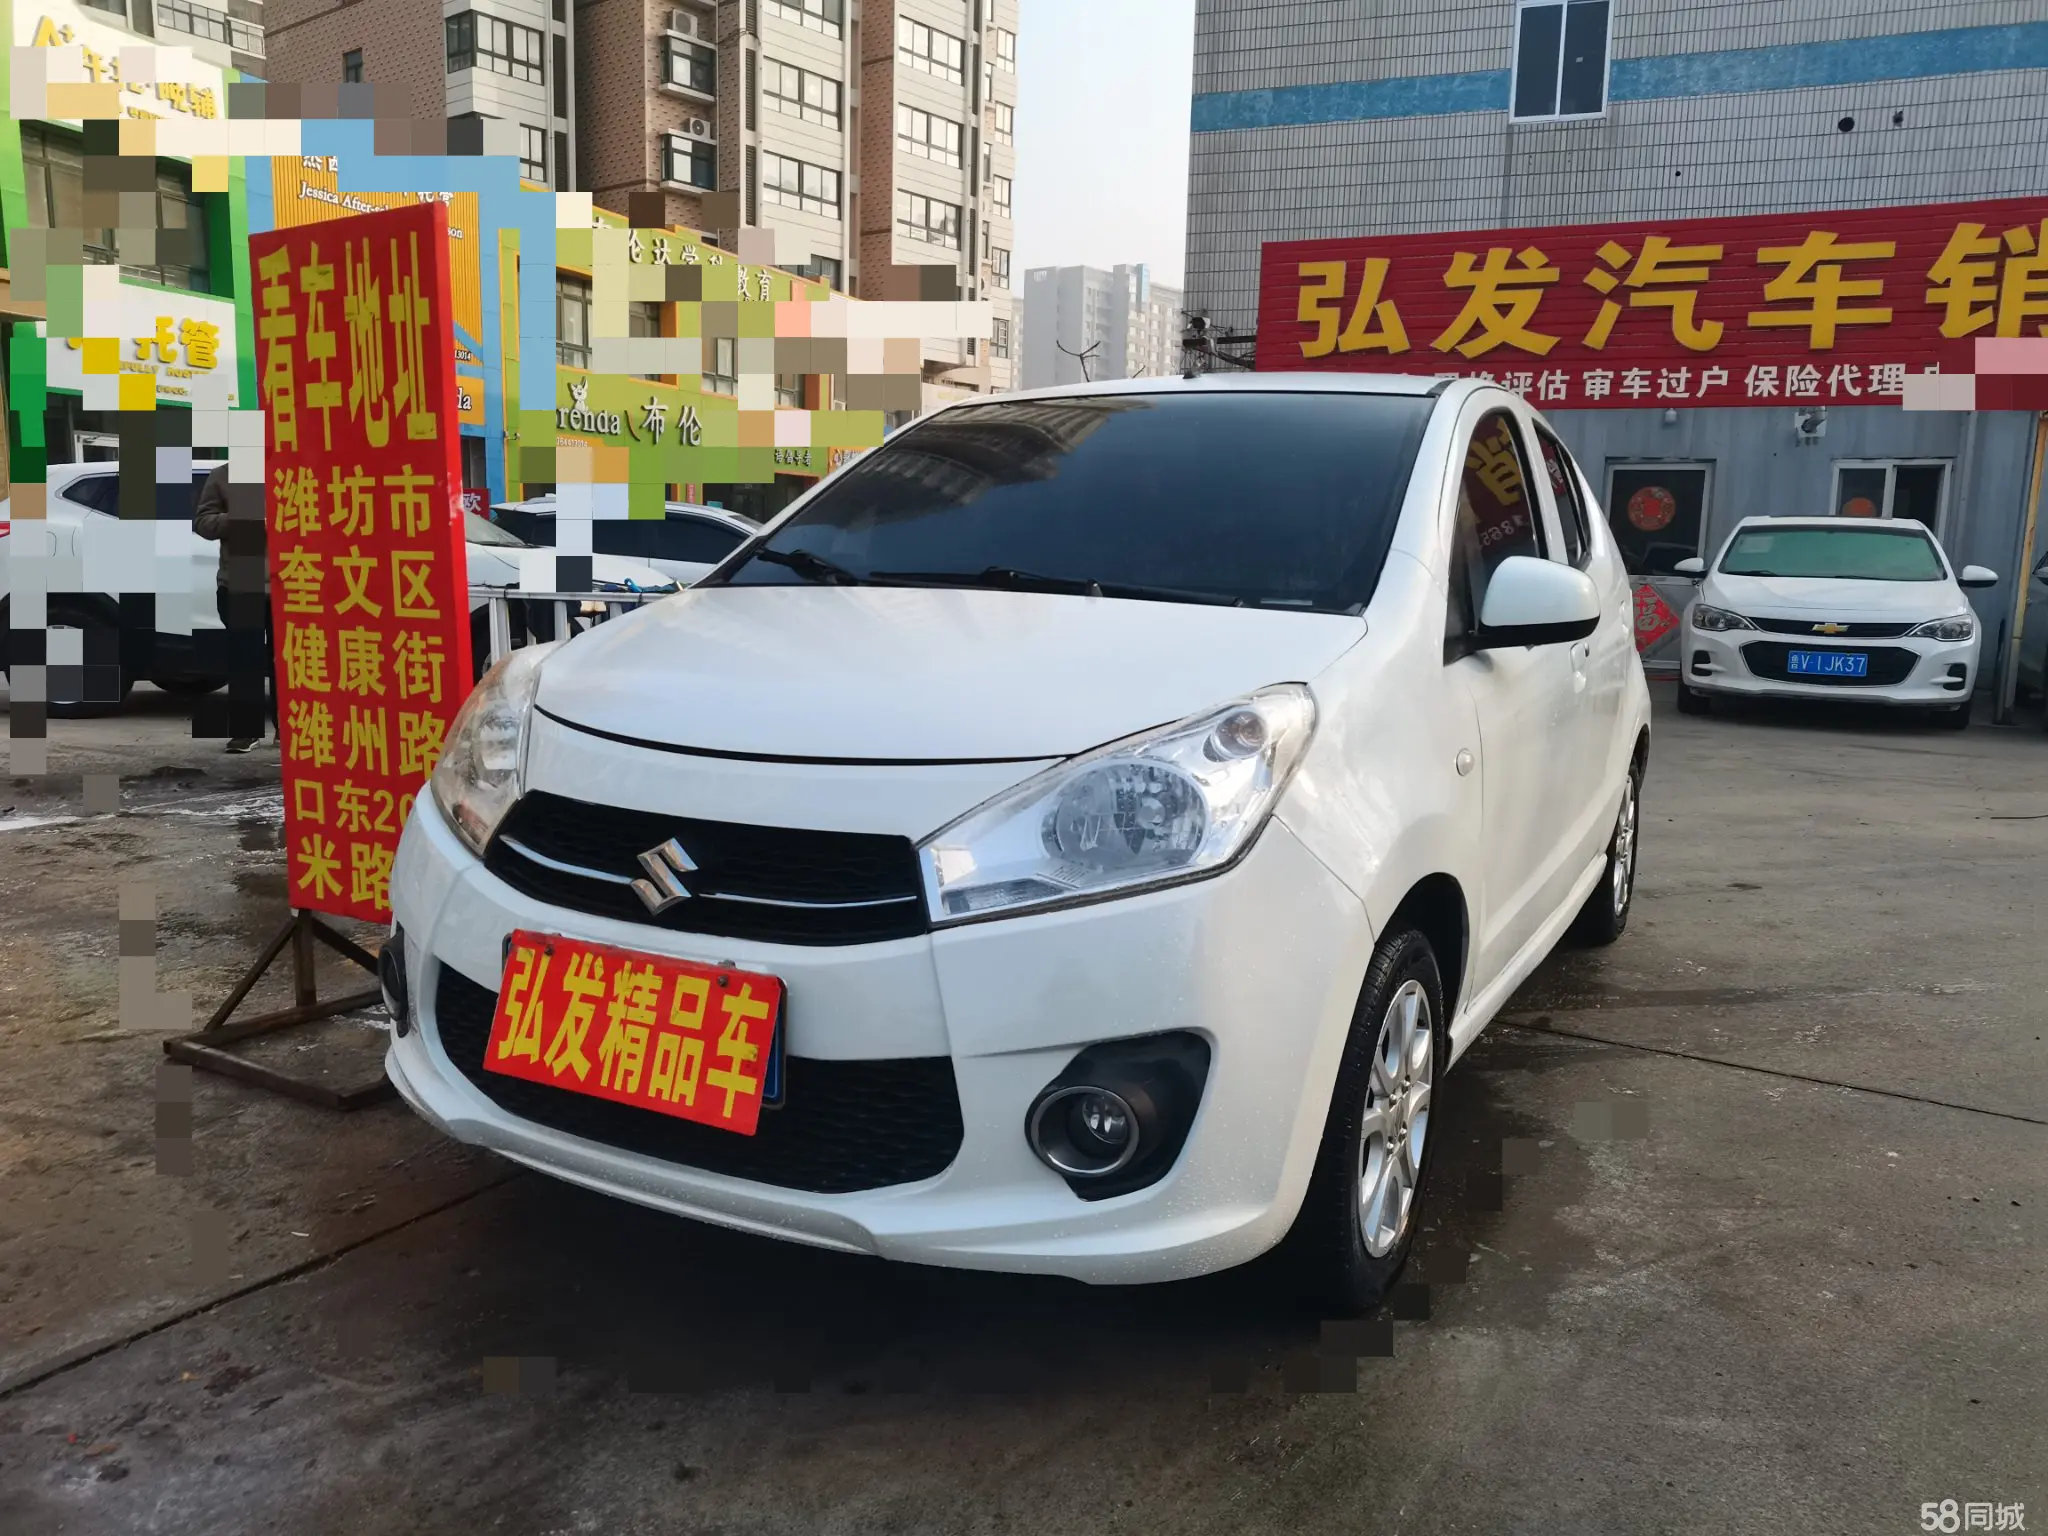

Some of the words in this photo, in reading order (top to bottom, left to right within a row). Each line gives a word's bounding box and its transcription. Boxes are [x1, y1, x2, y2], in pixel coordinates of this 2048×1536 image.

[299, 181, 339, 205] Jessica
[1296, 218, 2048, 359] 弘发汽车销
[1582, 366, 1729, 400] 审车过户
[1744, 364, 1906, 398] 保险代理
[556, 407, 621, 435] renda
[273, 464, 436, 538] 潍坊市
[279, 545, 441, 619] 奎文区
[282, 622, 446, 704] 健康街
[288, 700, 447, 781] 潍州路
[297, 833, 394, 911] 米路
[498, 946, 770, 1119] 弘发精品车
